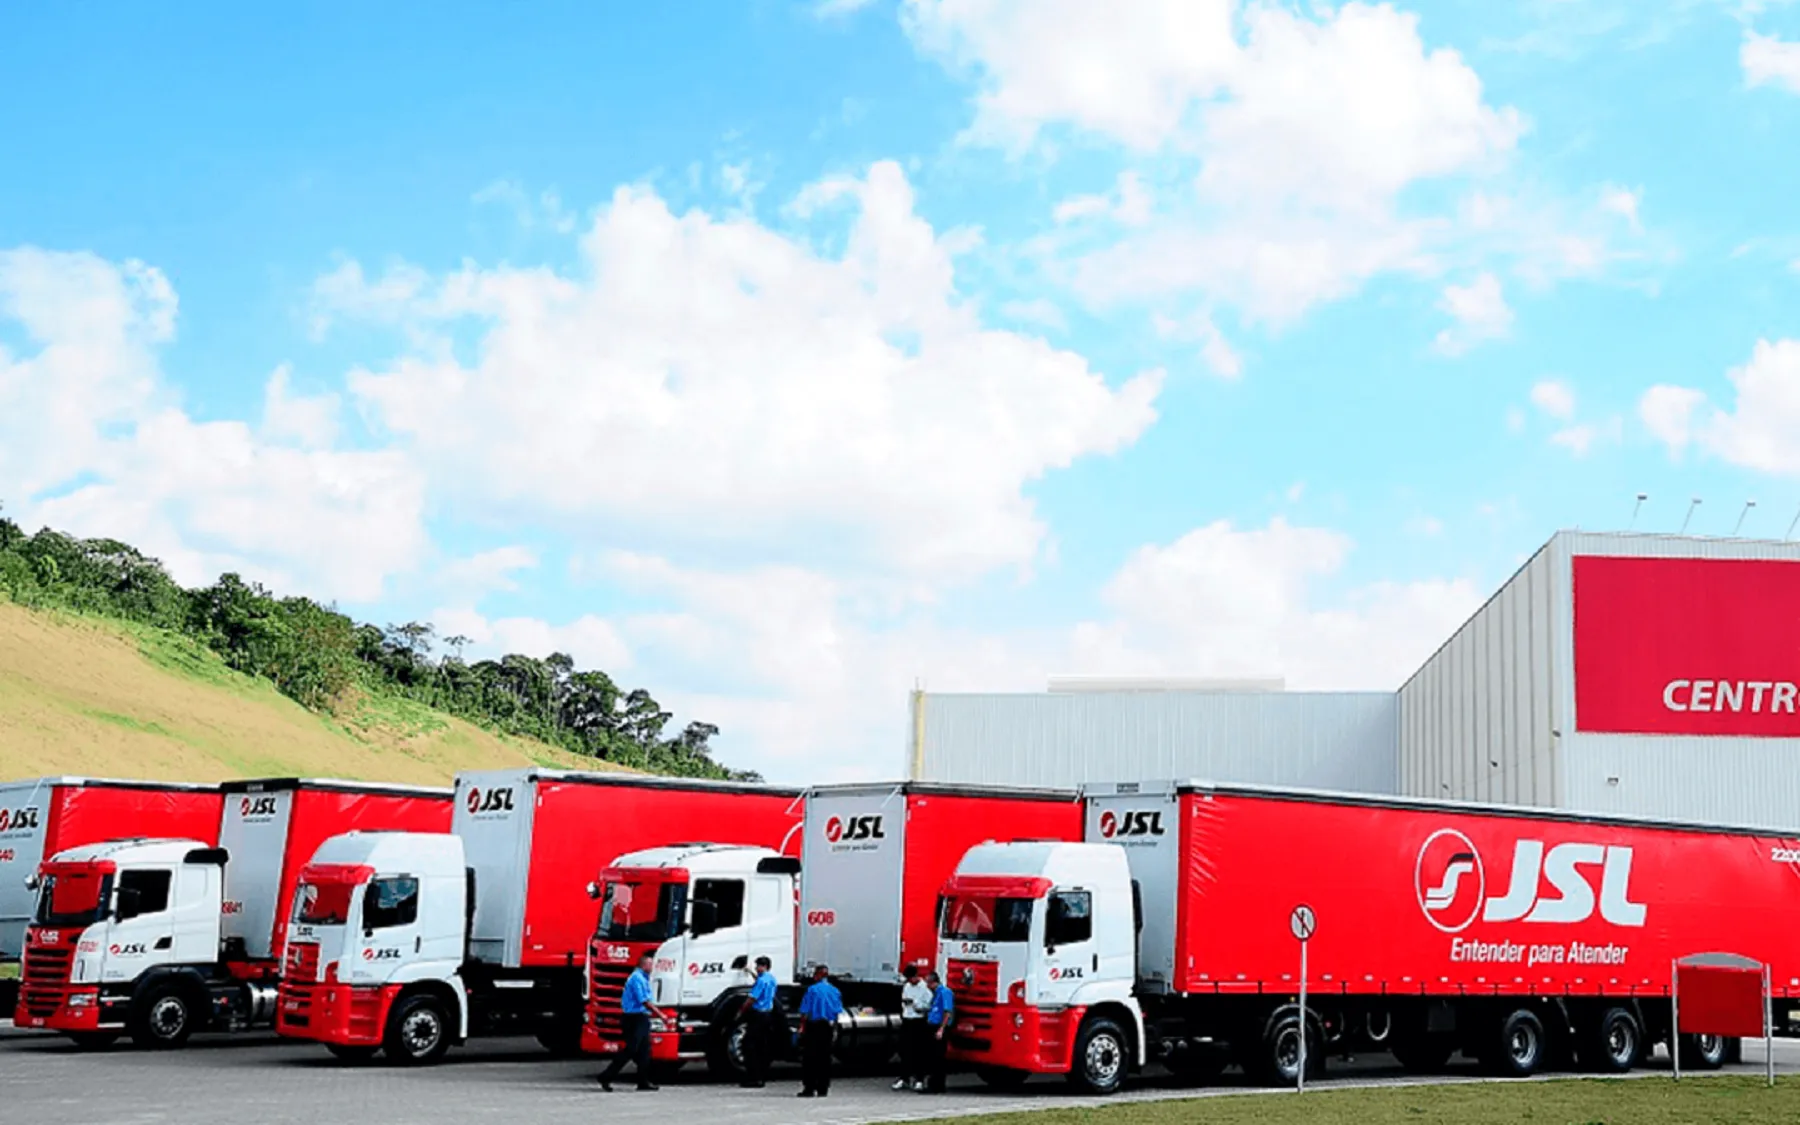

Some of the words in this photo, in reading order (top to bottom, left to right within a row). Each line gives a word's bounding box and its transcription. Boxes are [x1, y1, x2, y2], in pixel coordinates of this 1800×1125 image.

[1663, 679, 1800, 713] CENTR
[250, 797, 276, 814] JSL
[479, 787, 514, 811] JSL
[8, 809, 39, 829] JSL
[842, 816, 884, 840] JSL
[1117, 811, 1165, 836] JSL
[1483, 839, 1647, 927] JSL
[808, 911, 834, 926] 608
[120, 944, 147, 953] JSL
[374, 948, 401, 959] JSL
[968, 943, 988, 954] JSL
[1450, 938, 1525, 962] Entender
[1528, 945, 1565, 967] para
[1567, 941, 1628, 964] Atender
[701, 963, 725, 974] JSL
[1060, 967, 1084, 978] JSL
